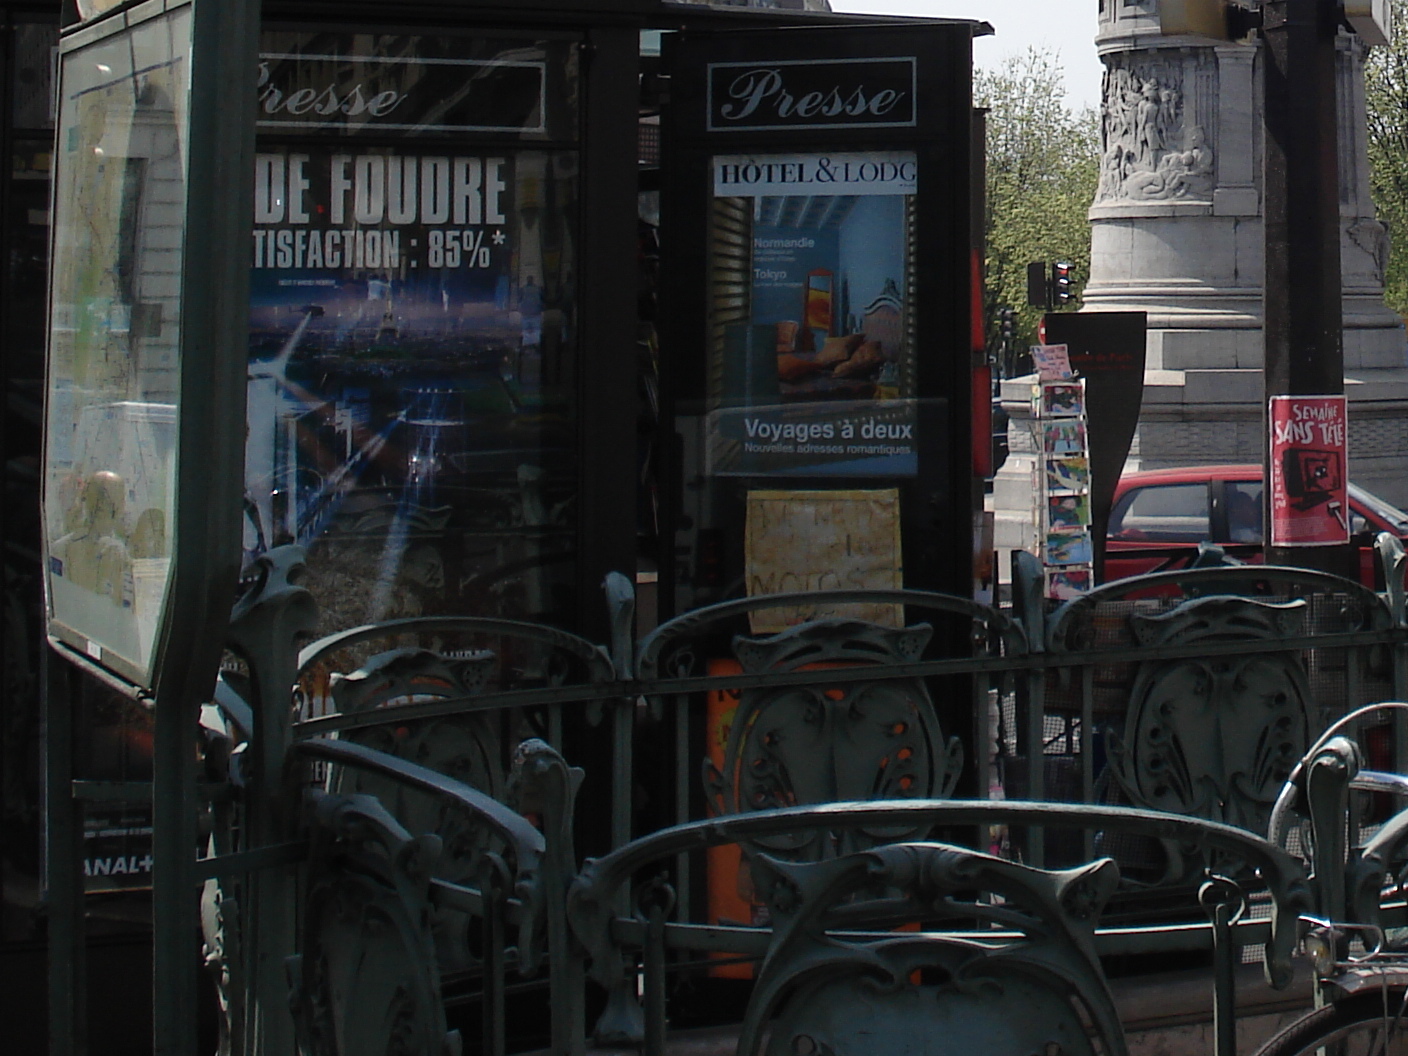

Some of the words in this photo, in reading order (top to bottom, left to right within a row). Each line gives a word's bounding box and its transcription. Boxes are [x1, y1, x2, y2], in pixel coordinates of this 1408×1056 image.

[258, 61, 408, 118] resse
[721, 68, 906, 121] Presse
[253, 152, 311, 225] DE
[330, 154, 507, 226] FOUDRE
[250, 229, 400, 270] TISFACTION
[753, 236, 816, 249] Normandie
[753, 267, 788, 281] Tokyo
[1292, 402, 1338, 421] SEMAINE
[744, 418, 835, 443] Voyages
[840, 419, 855, 440] à
[861, 417, 913, 440] deux
[1274, 419, 1315, 445] SANS
[744, 443, 795, 454] Nouvelles
[797, 443, 845, 454] adresses
[847, 444, 912, 457] romantiques
